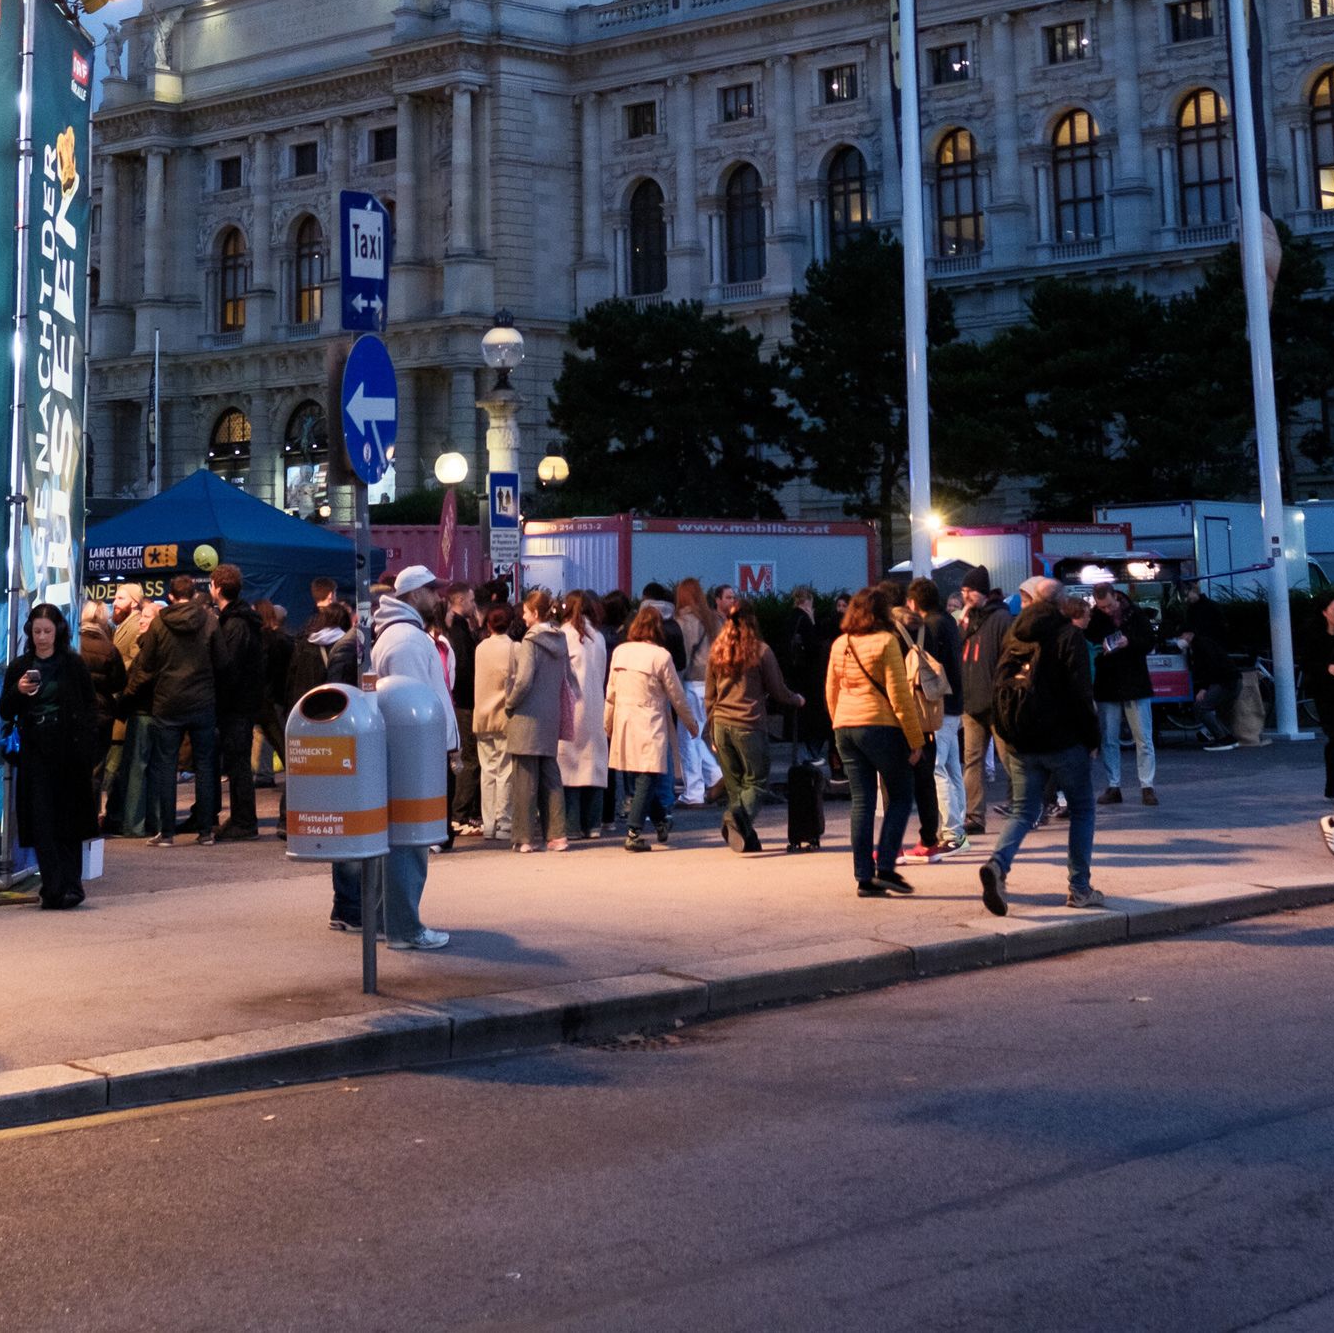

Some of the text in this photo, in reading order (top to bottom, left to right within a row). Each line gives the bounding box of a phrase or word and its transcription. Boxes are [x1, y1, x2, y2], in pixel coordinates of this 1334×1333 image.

[41, 143, 57, 261] DER
[352, 223, 381, 260] Taxi
[677, 521, 831, 534] www.mobilbox.at
[1049, 526, 1122, 534] www.mobilbox.at
[89, 545, 144, 559] LANGE NACHT
[88, 557, 143, 571] DER MUSEEN
[298, 813, 344, 823] Misttelefon
[306, 825, 334, 835] 546 48
